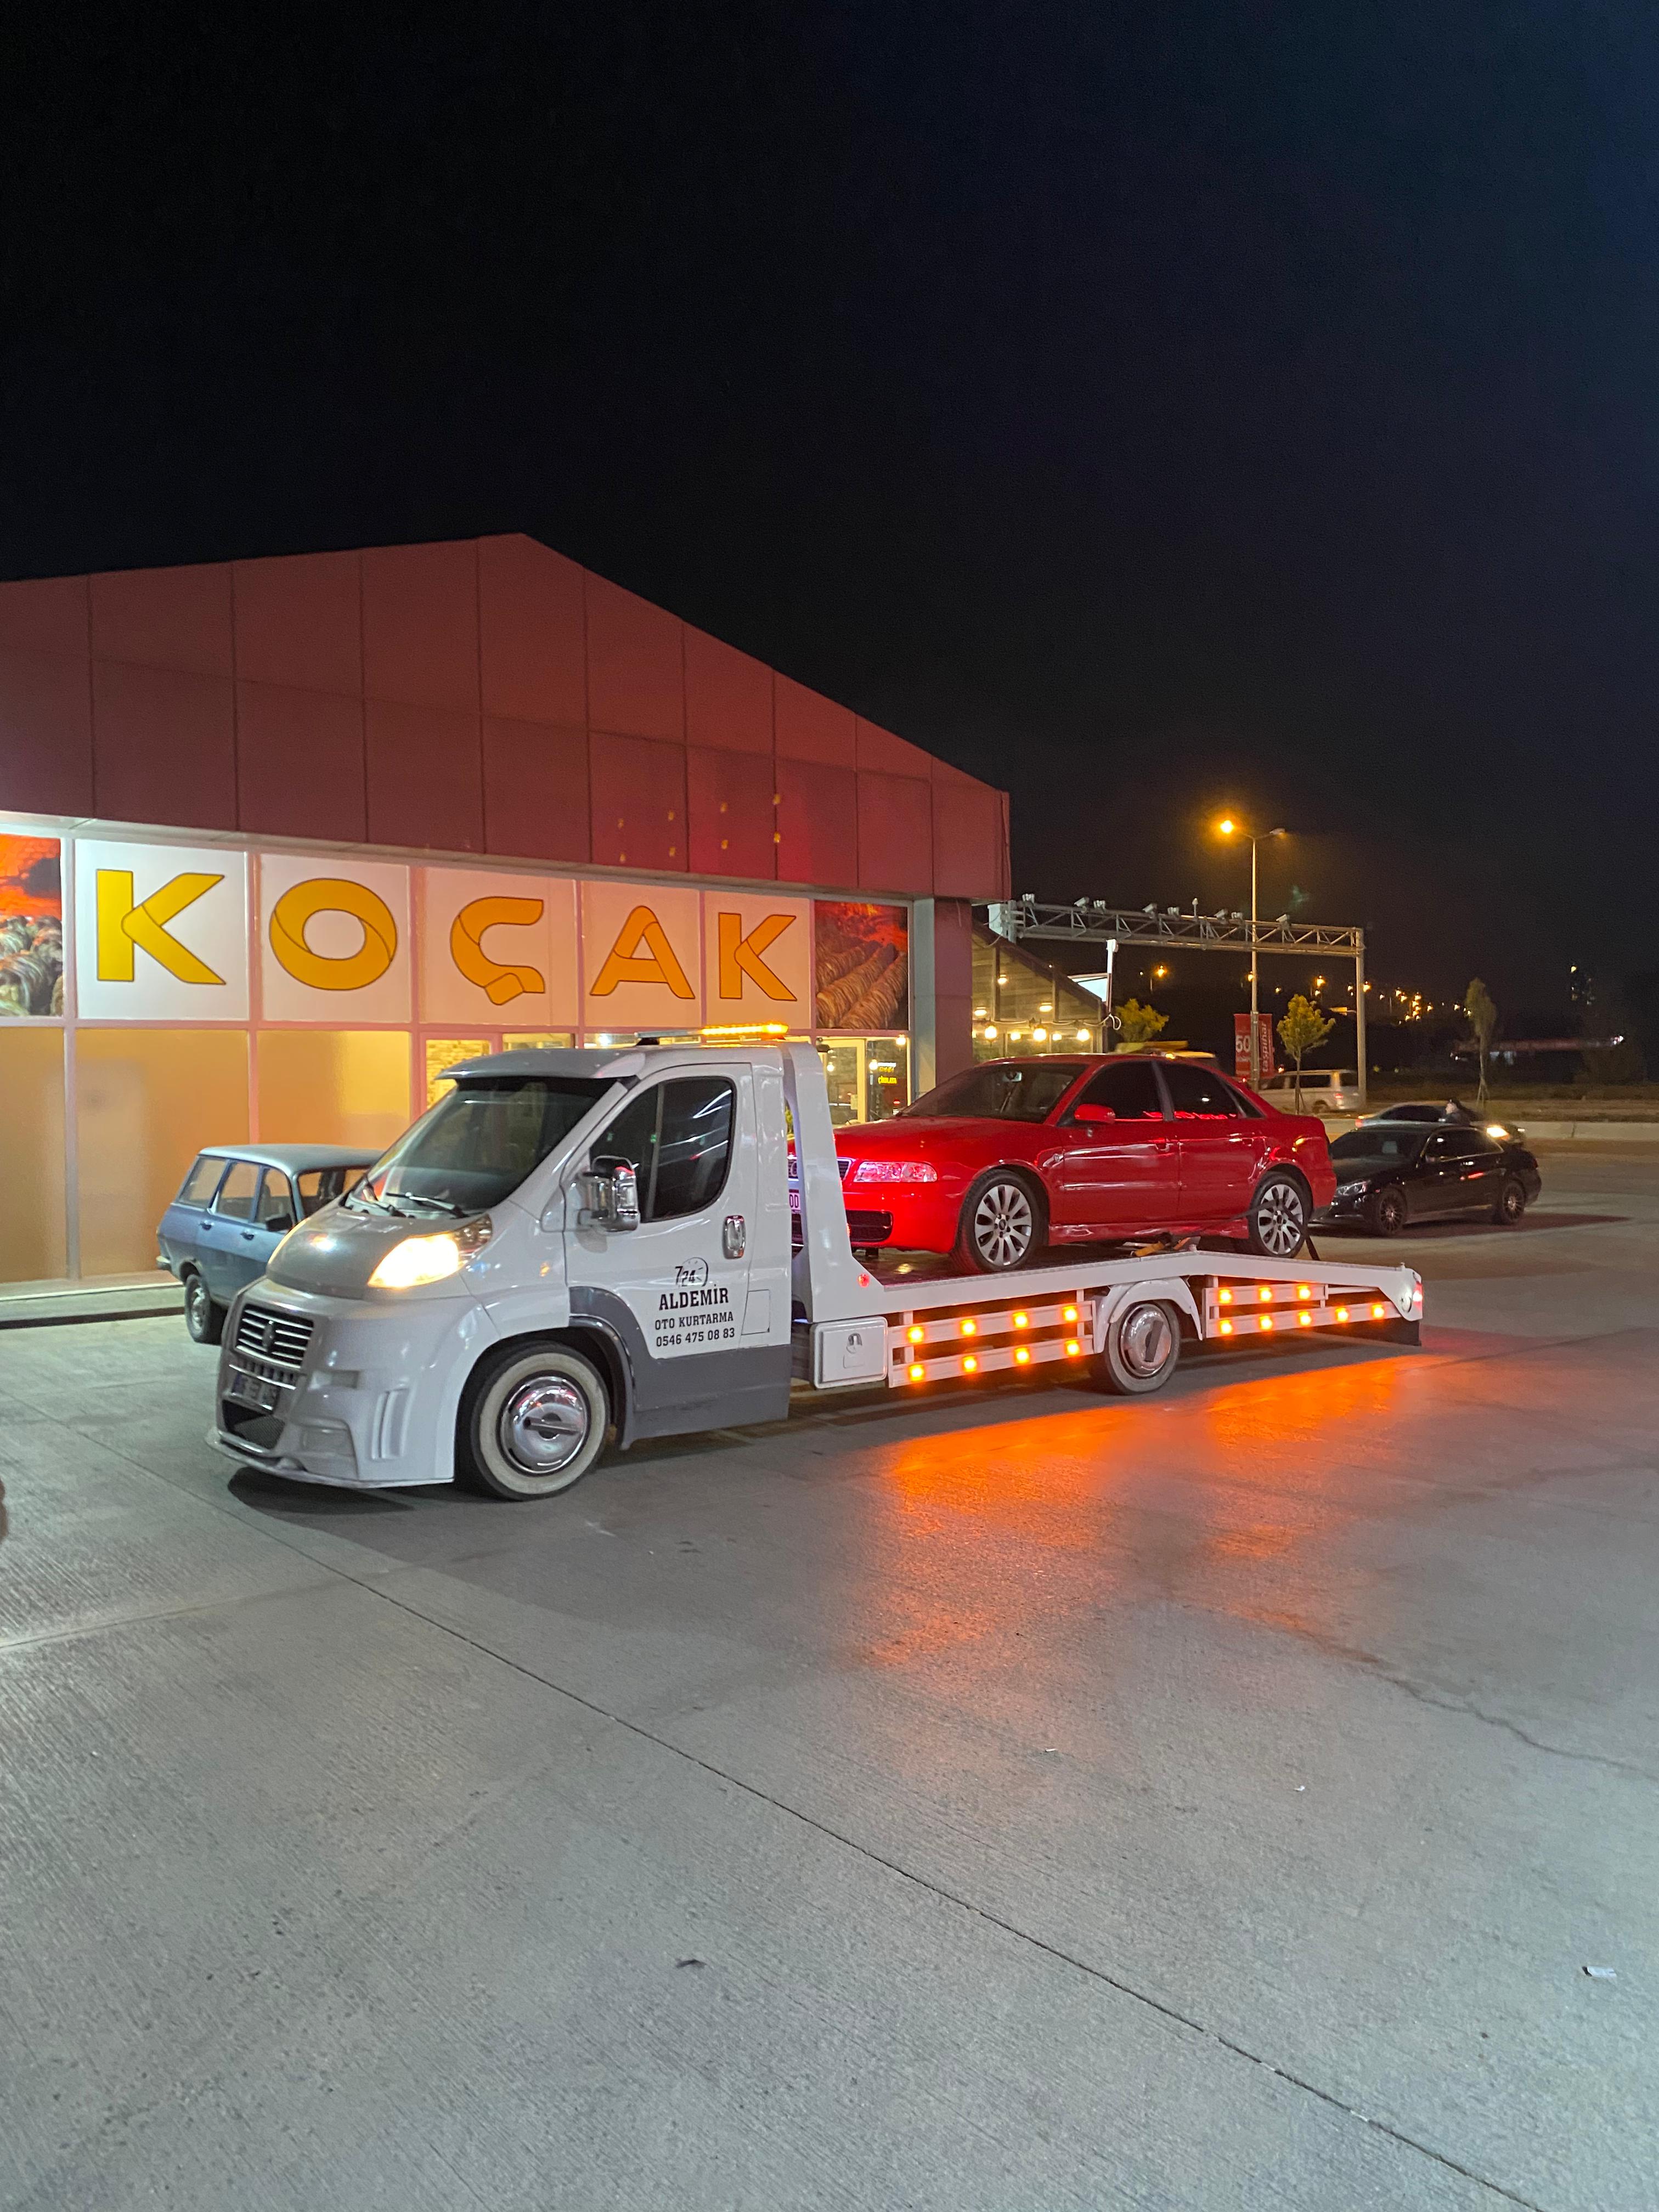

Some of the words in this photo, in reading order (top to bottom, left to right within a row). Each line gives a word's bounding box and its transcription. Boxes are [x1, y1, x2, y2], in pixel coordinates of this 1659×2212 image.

[96, 868, 798, 1006] KOÇAK
[1235, 1035, 1251, 1053] 50
[659, 1284, 729, 1311] ALDEMİR
[655, 1318, 675, 1330] OTO
[679, 1311, 733, 1328] KURTARMA
[656, 1334, 681, 1347] 0546
[685, 1331, 704, 1343] 475
[708, 1329, 720, 1340] 08
[723, 1327, 735, 1339] 83
